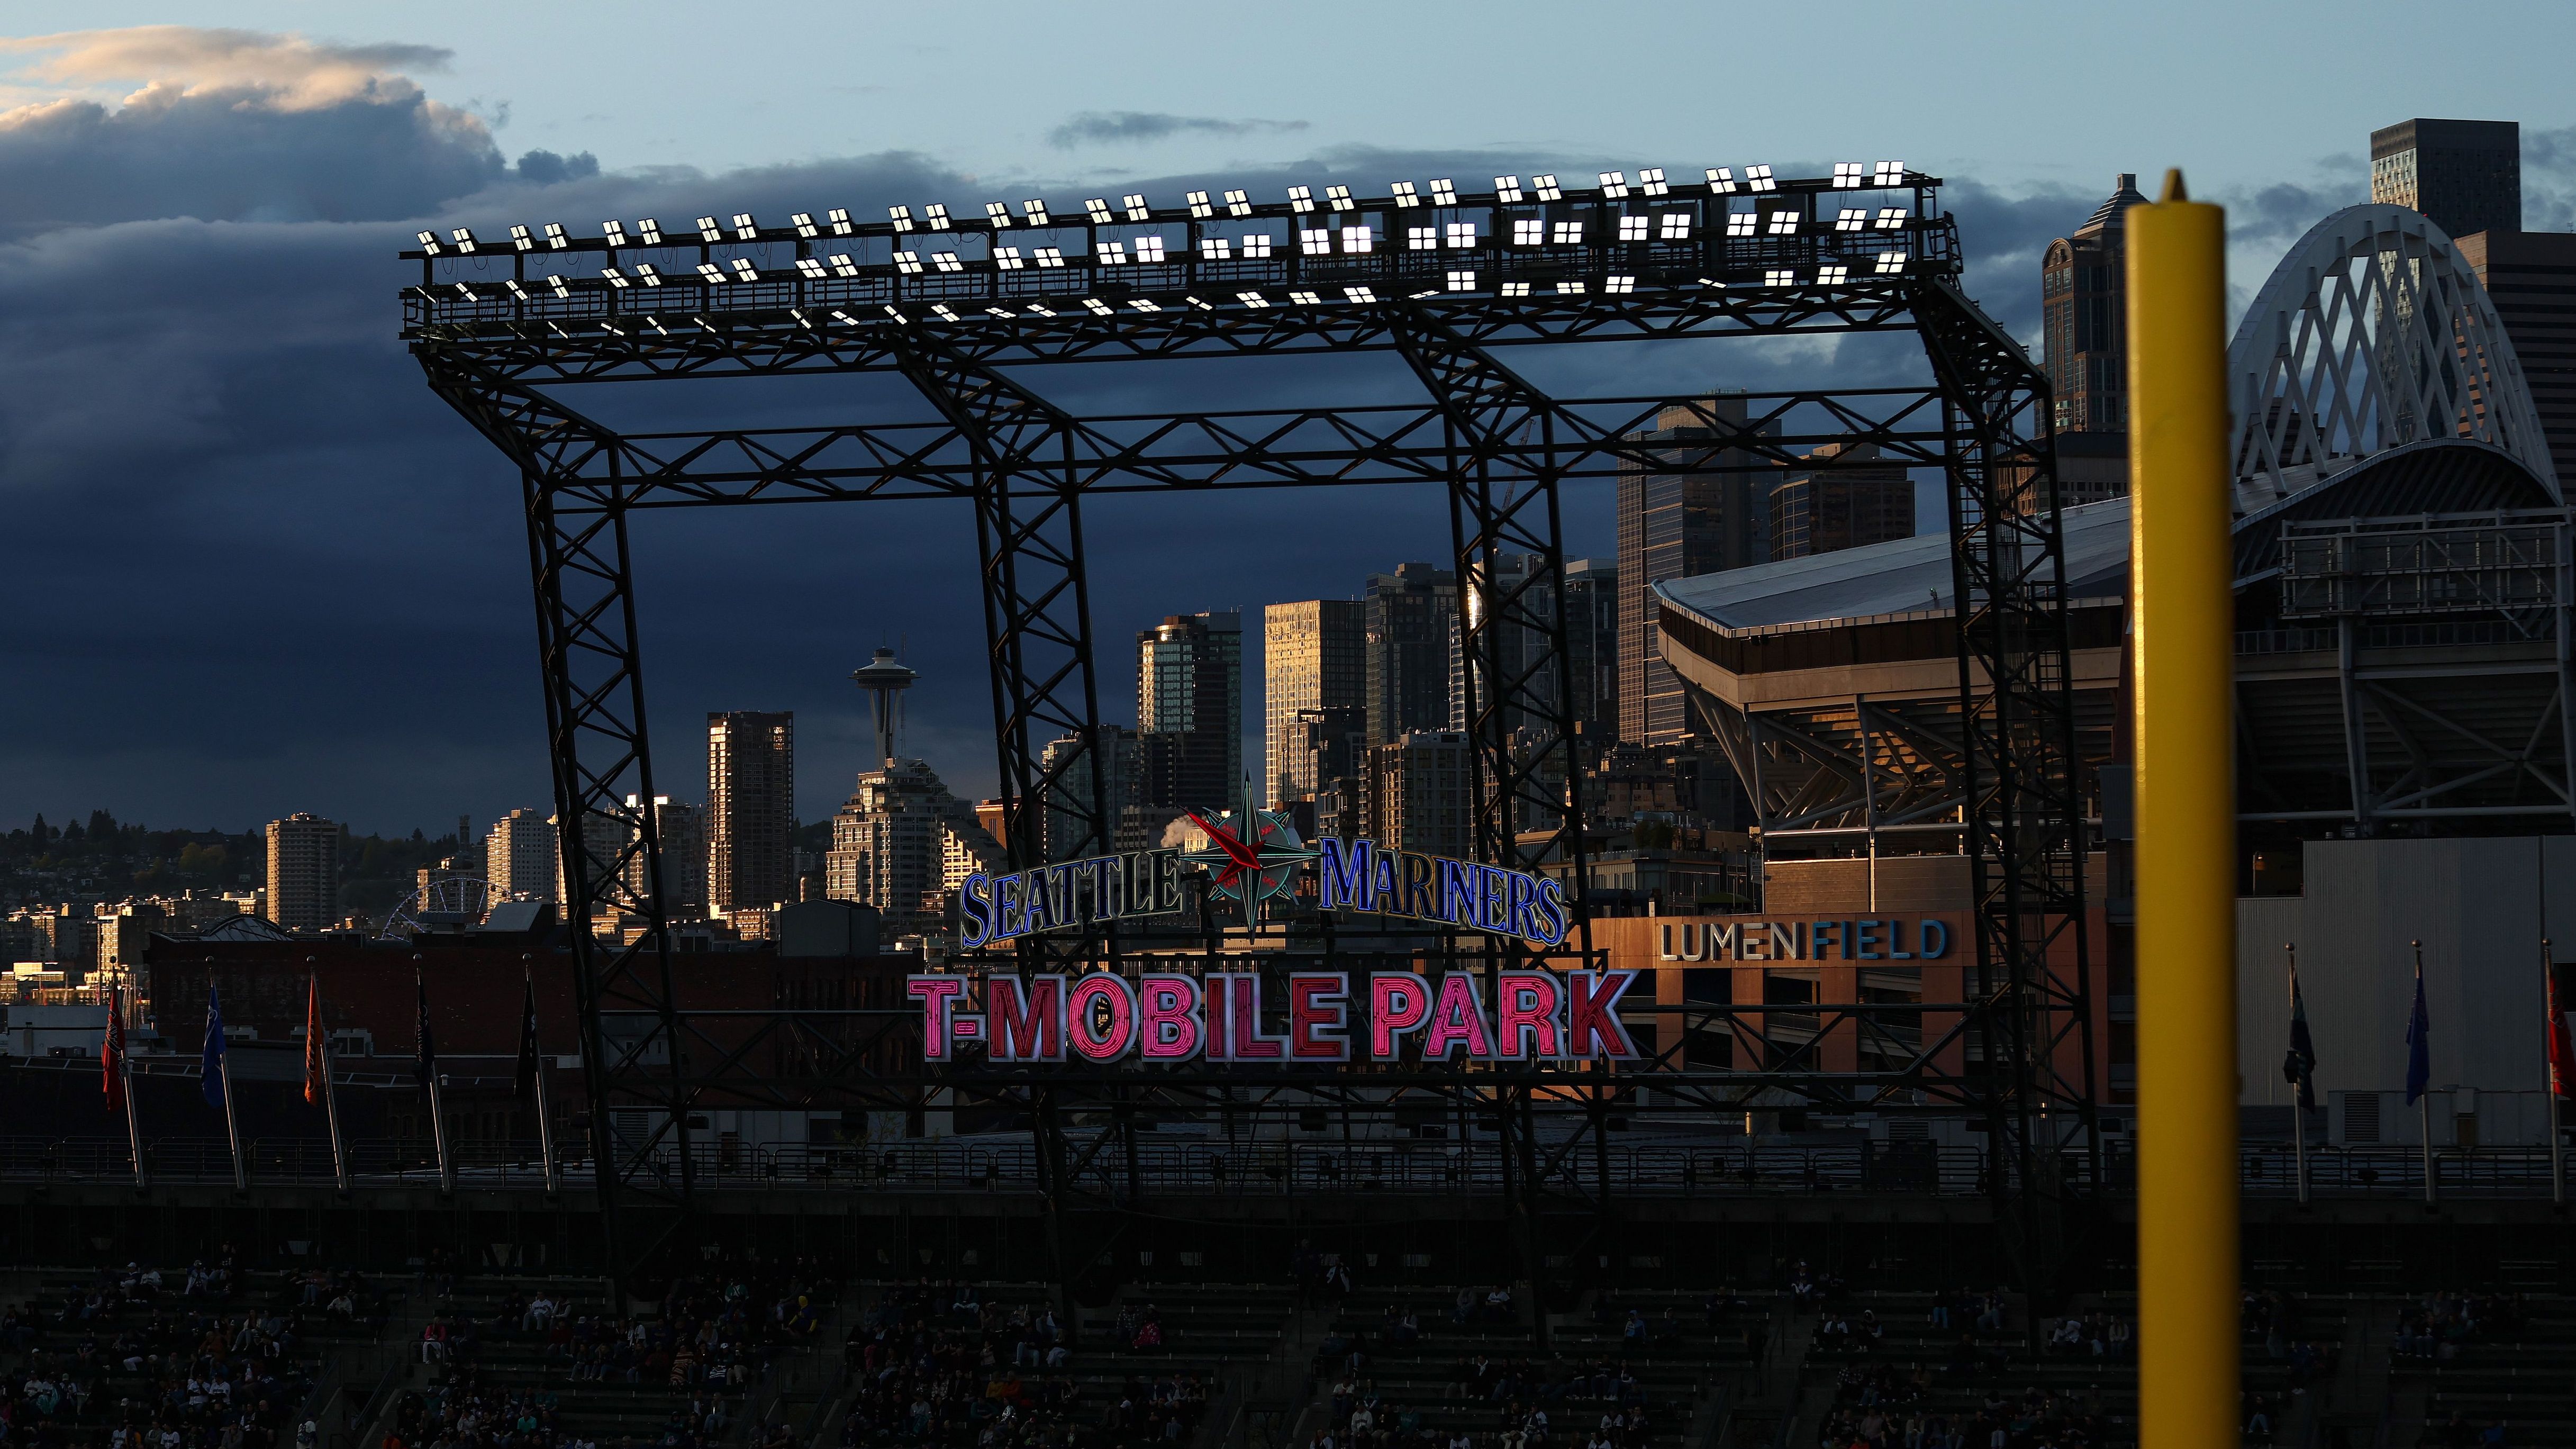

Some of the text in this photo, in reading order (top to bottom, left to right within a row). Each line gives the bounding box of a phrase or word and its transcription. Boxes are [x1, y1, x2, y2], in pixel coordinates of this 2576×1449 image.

[960, 835, 1567, 949] SEATTLE MARINERS
[1661, 919, 1947, 961] LUMEN FIELD
[907, 970, 1641, 1063] T-MOBILE PARK
